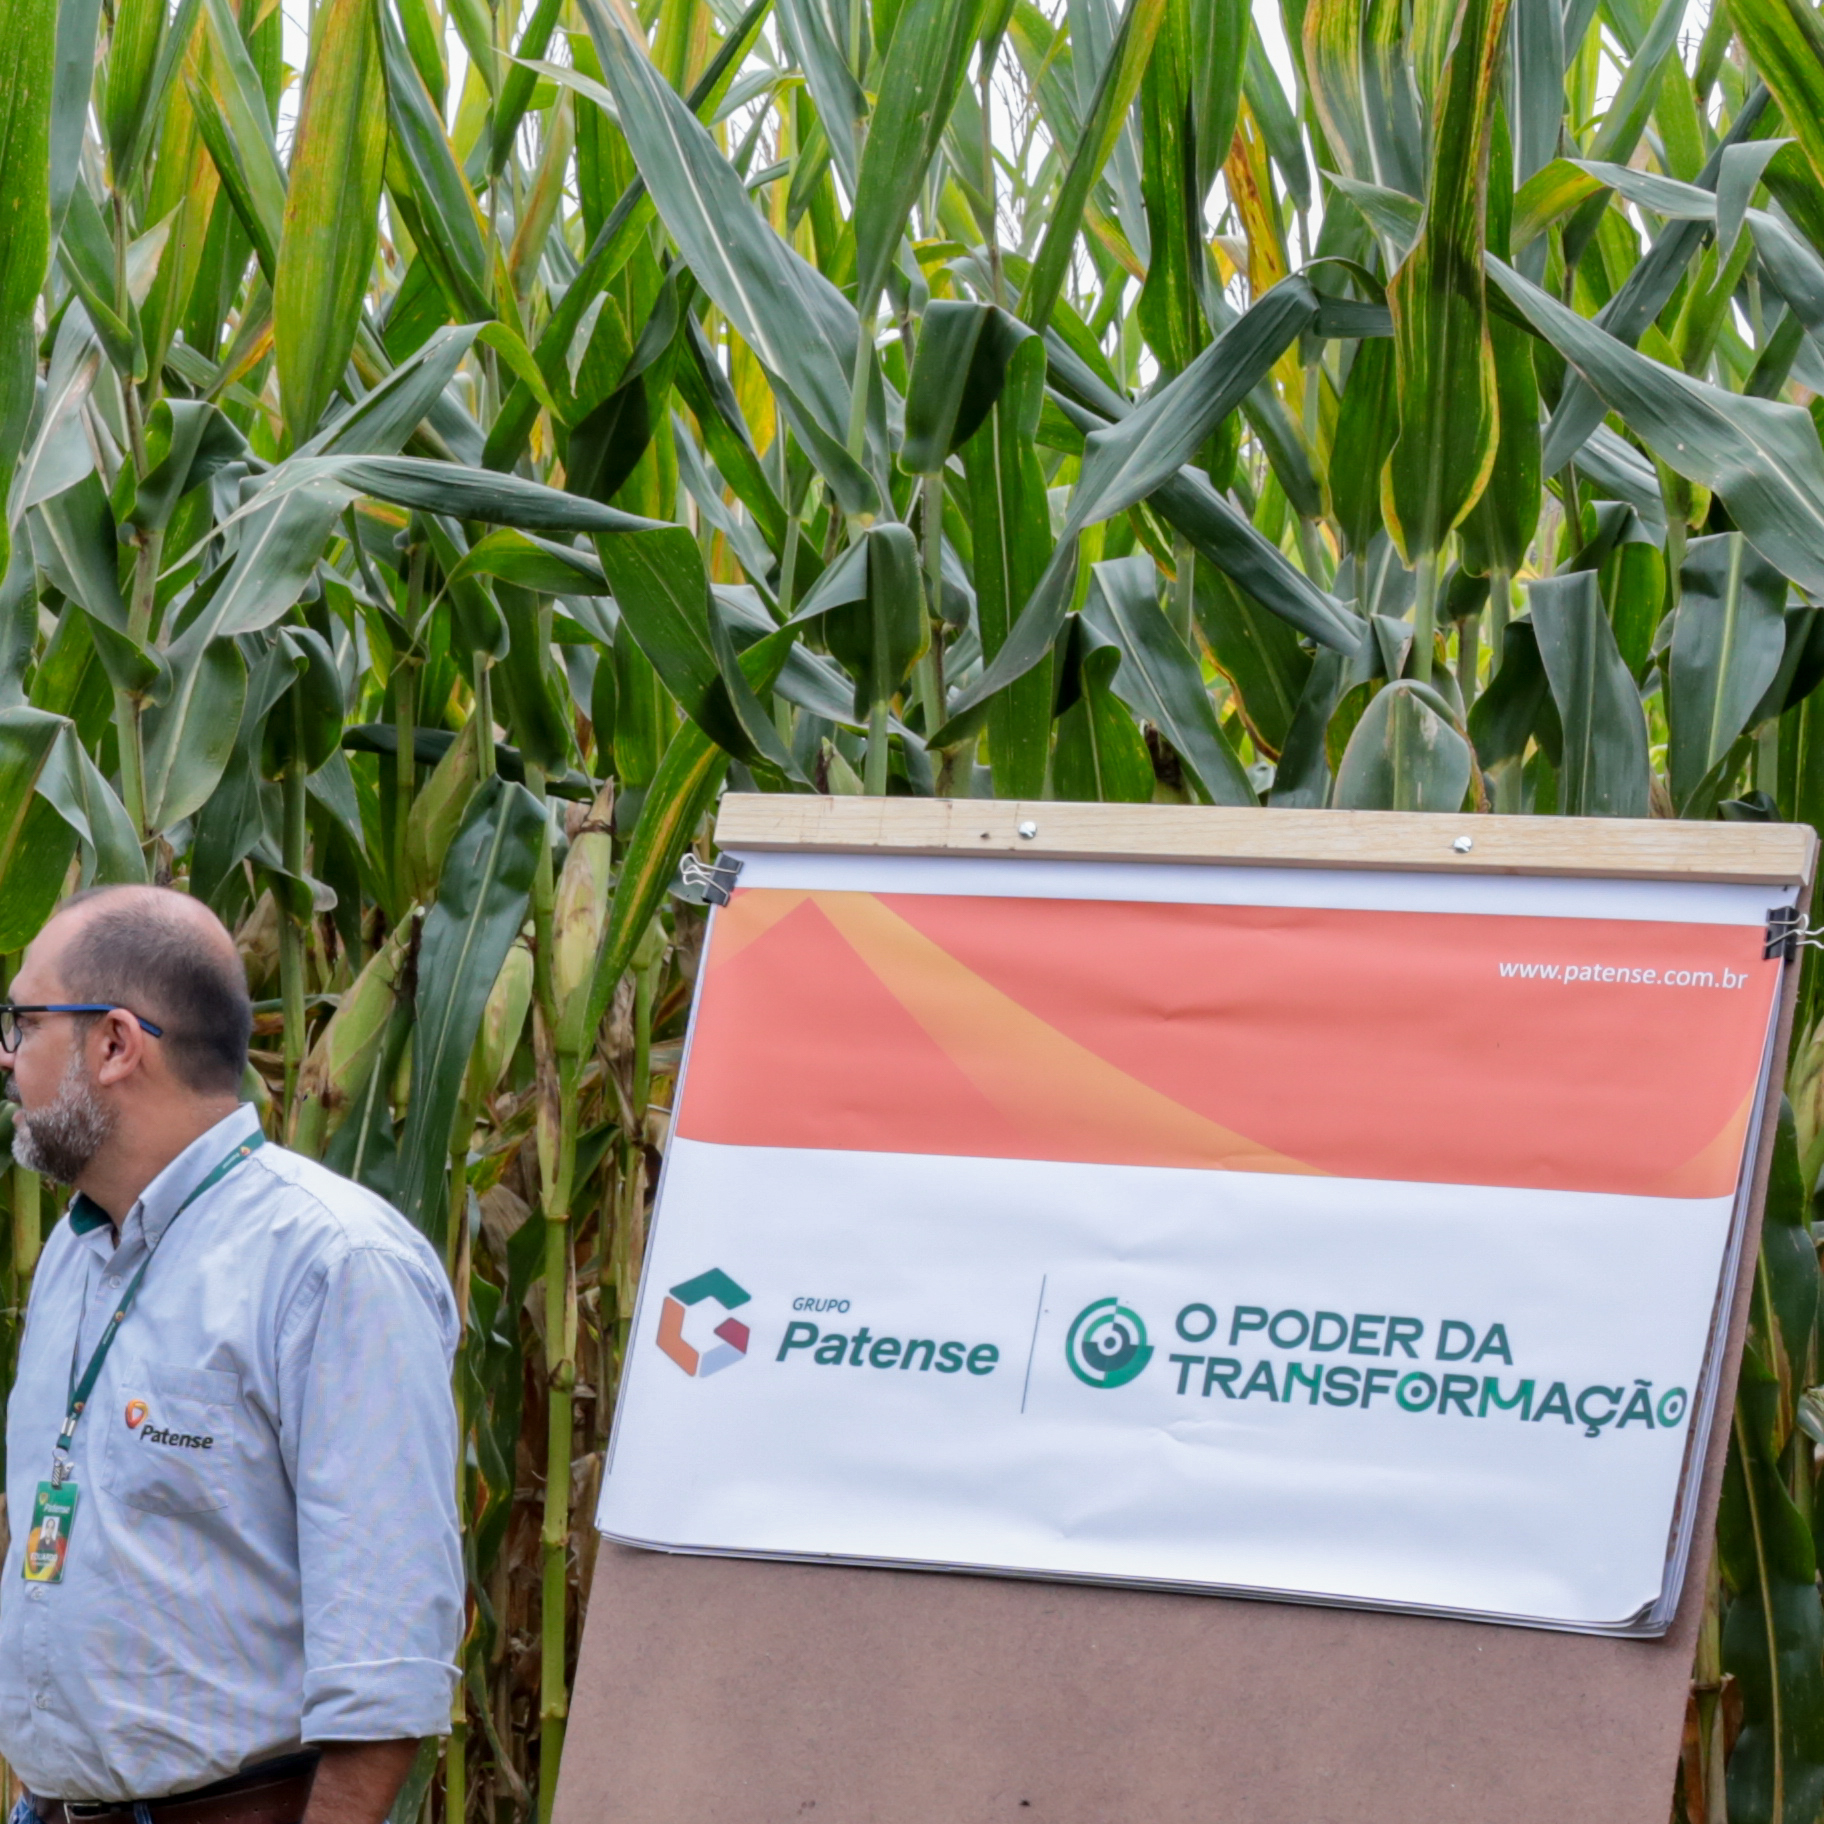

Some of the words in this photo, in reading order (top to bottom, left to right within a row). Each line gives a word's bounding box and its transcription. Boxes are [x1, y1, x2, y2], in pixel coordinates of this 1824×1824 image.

[1499, 962, 1748, 989] www.patense.com.br
[792, 1297, 850, 1314] GRUPO
[775, 1321, 1000, 1375] Patense
[1175, 1303, 1217, 1342] O
[1228, 1305, 1424, 1360] PODER
[1435, 1319, 1514, 1366] DA
[1168, 1353, 1688, 1438] TRANSFORMAÇÃO
[140, 1424, 214, 1450] Patense
